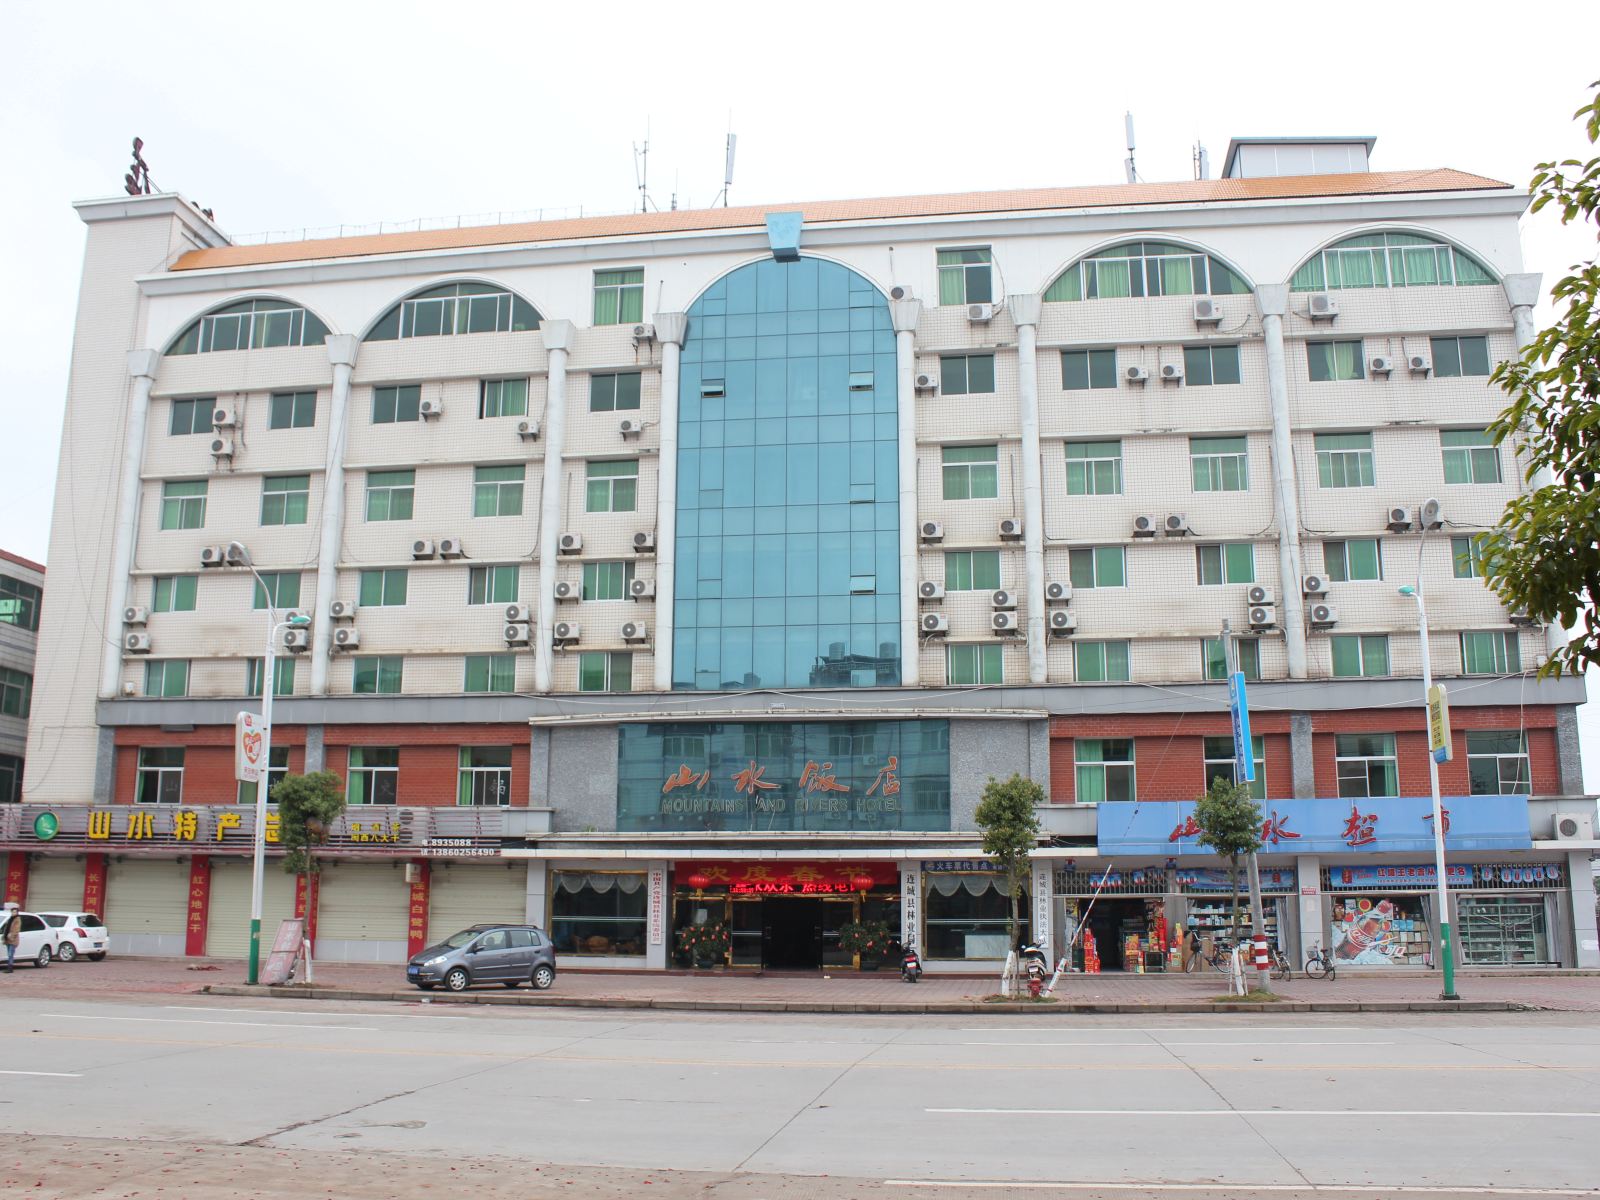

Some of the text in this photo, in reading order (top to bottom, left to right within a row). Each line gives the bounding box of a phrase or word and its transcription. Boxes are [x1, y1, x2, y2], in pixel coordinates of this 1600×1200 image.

[663, 756, 900, 796] 山水饭店
[662, 798, 903, 815] MOUNTAINS AND RIVERS HOTEL
[432, 838, 472, 847] 8935088
[432, 848, 495, 857] 13860256490
[700, 865, 872, 882] 欢度春节
[906, 873, 916, 945] 连城县林业局
